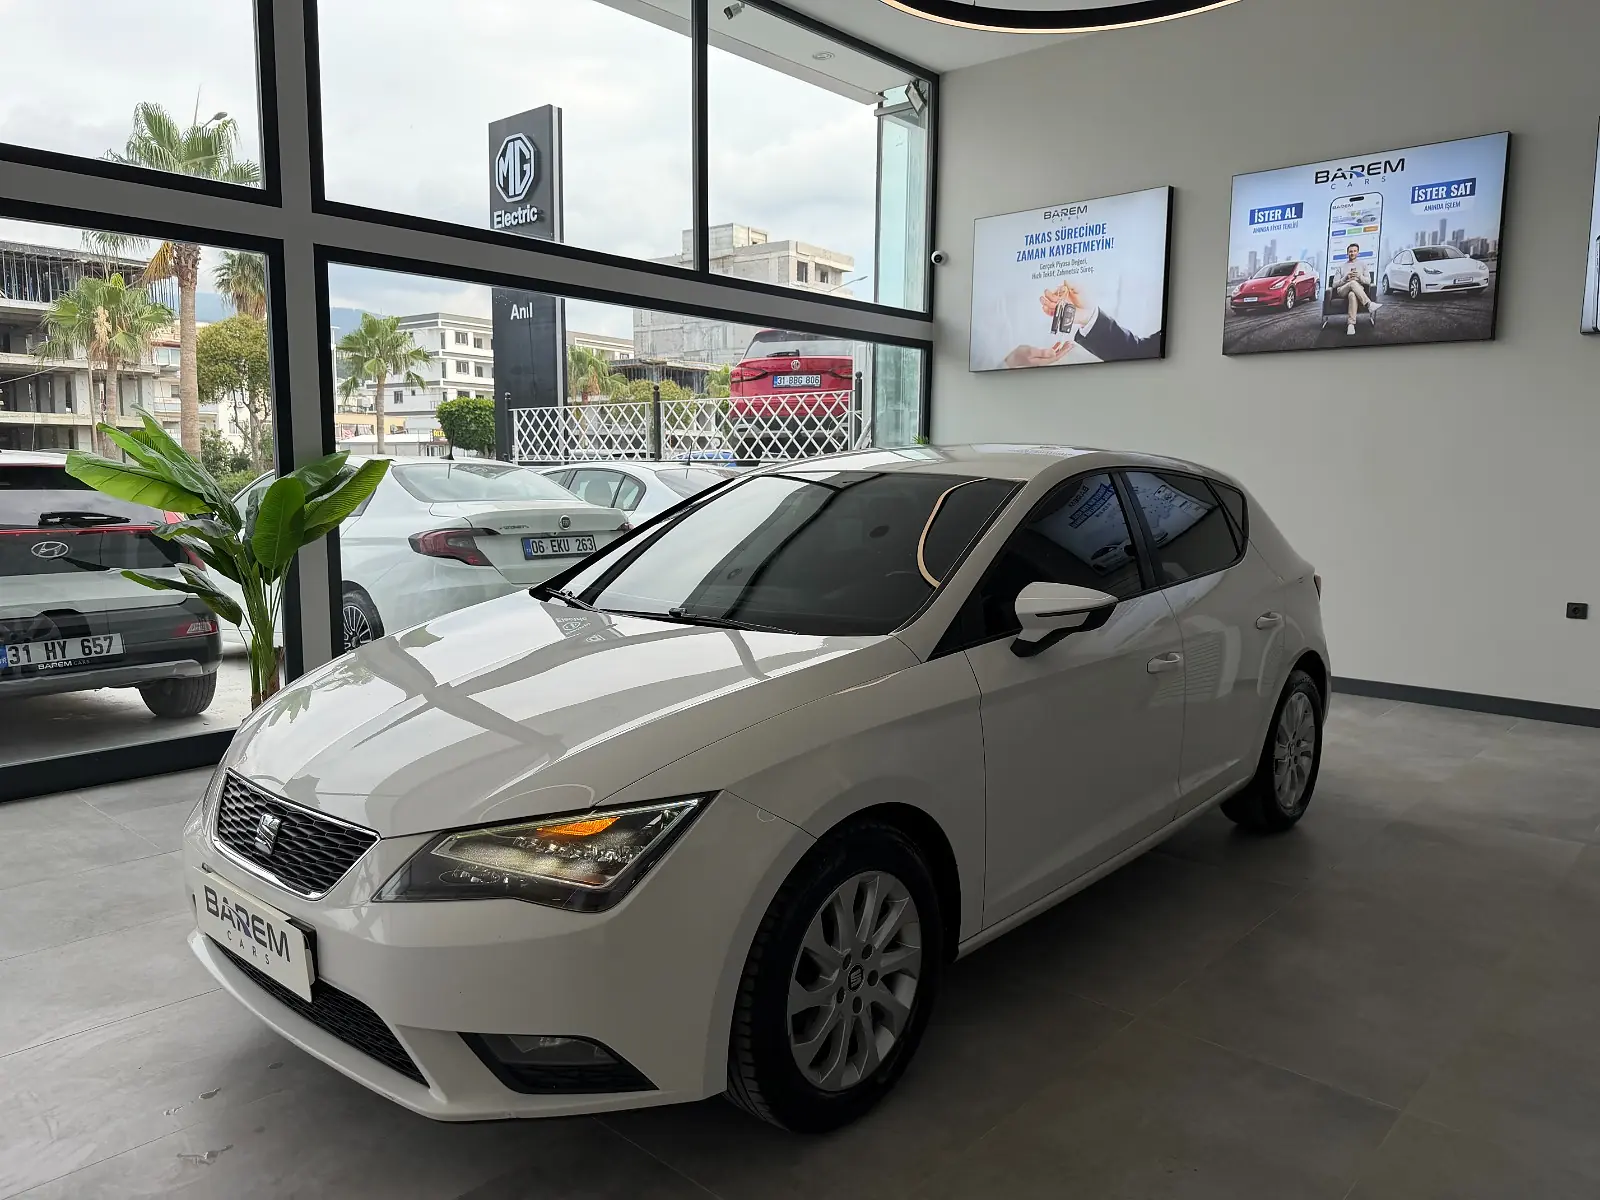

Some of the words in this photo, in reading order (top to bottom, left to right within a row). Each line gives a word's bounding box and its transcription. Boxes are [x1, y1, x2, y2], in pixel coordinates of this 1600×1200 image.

[498, 138, 531, 197] MG
[1314, 157, 1406, 185] BAREM
[1330, 175, 1387, 190] CARS
[1414, 186, 1447, 202] İSTER
[1450, 181, 1473, 197] SAT
[493, 203, 538, 229] Electric
[1043, 205, 1088, 220] BAREM
[1254, 209, 1282, 223] İSTER
[1284, 206, 1298, 219] AL
[1024, 231, 1052, 246] TAKAS
[1054, 222, 1107, 242] SÜRECİNDE
[1016, 247, 1046, 262] ZAMAN
[1049, 235, 1114, 258] KAYBETMEYİN!
[509, 302, 533, 321] Anıl
[777, 376, 785, 385] 31
[805, 375, 820, 384] 806
[531, 540, 545, 554] 06
[550, 538, 570, 553] EKU
[575, 537, 594, 552] 263
[8, 644, 32, 665] 31
[44, 640, 68, 661] HY
[80, 635, 114, 657] 657
[37, 660, 73, 670] BAREM
[204, 884, 291, 963] BAREM
[227, 930, 270, 965] CARS
